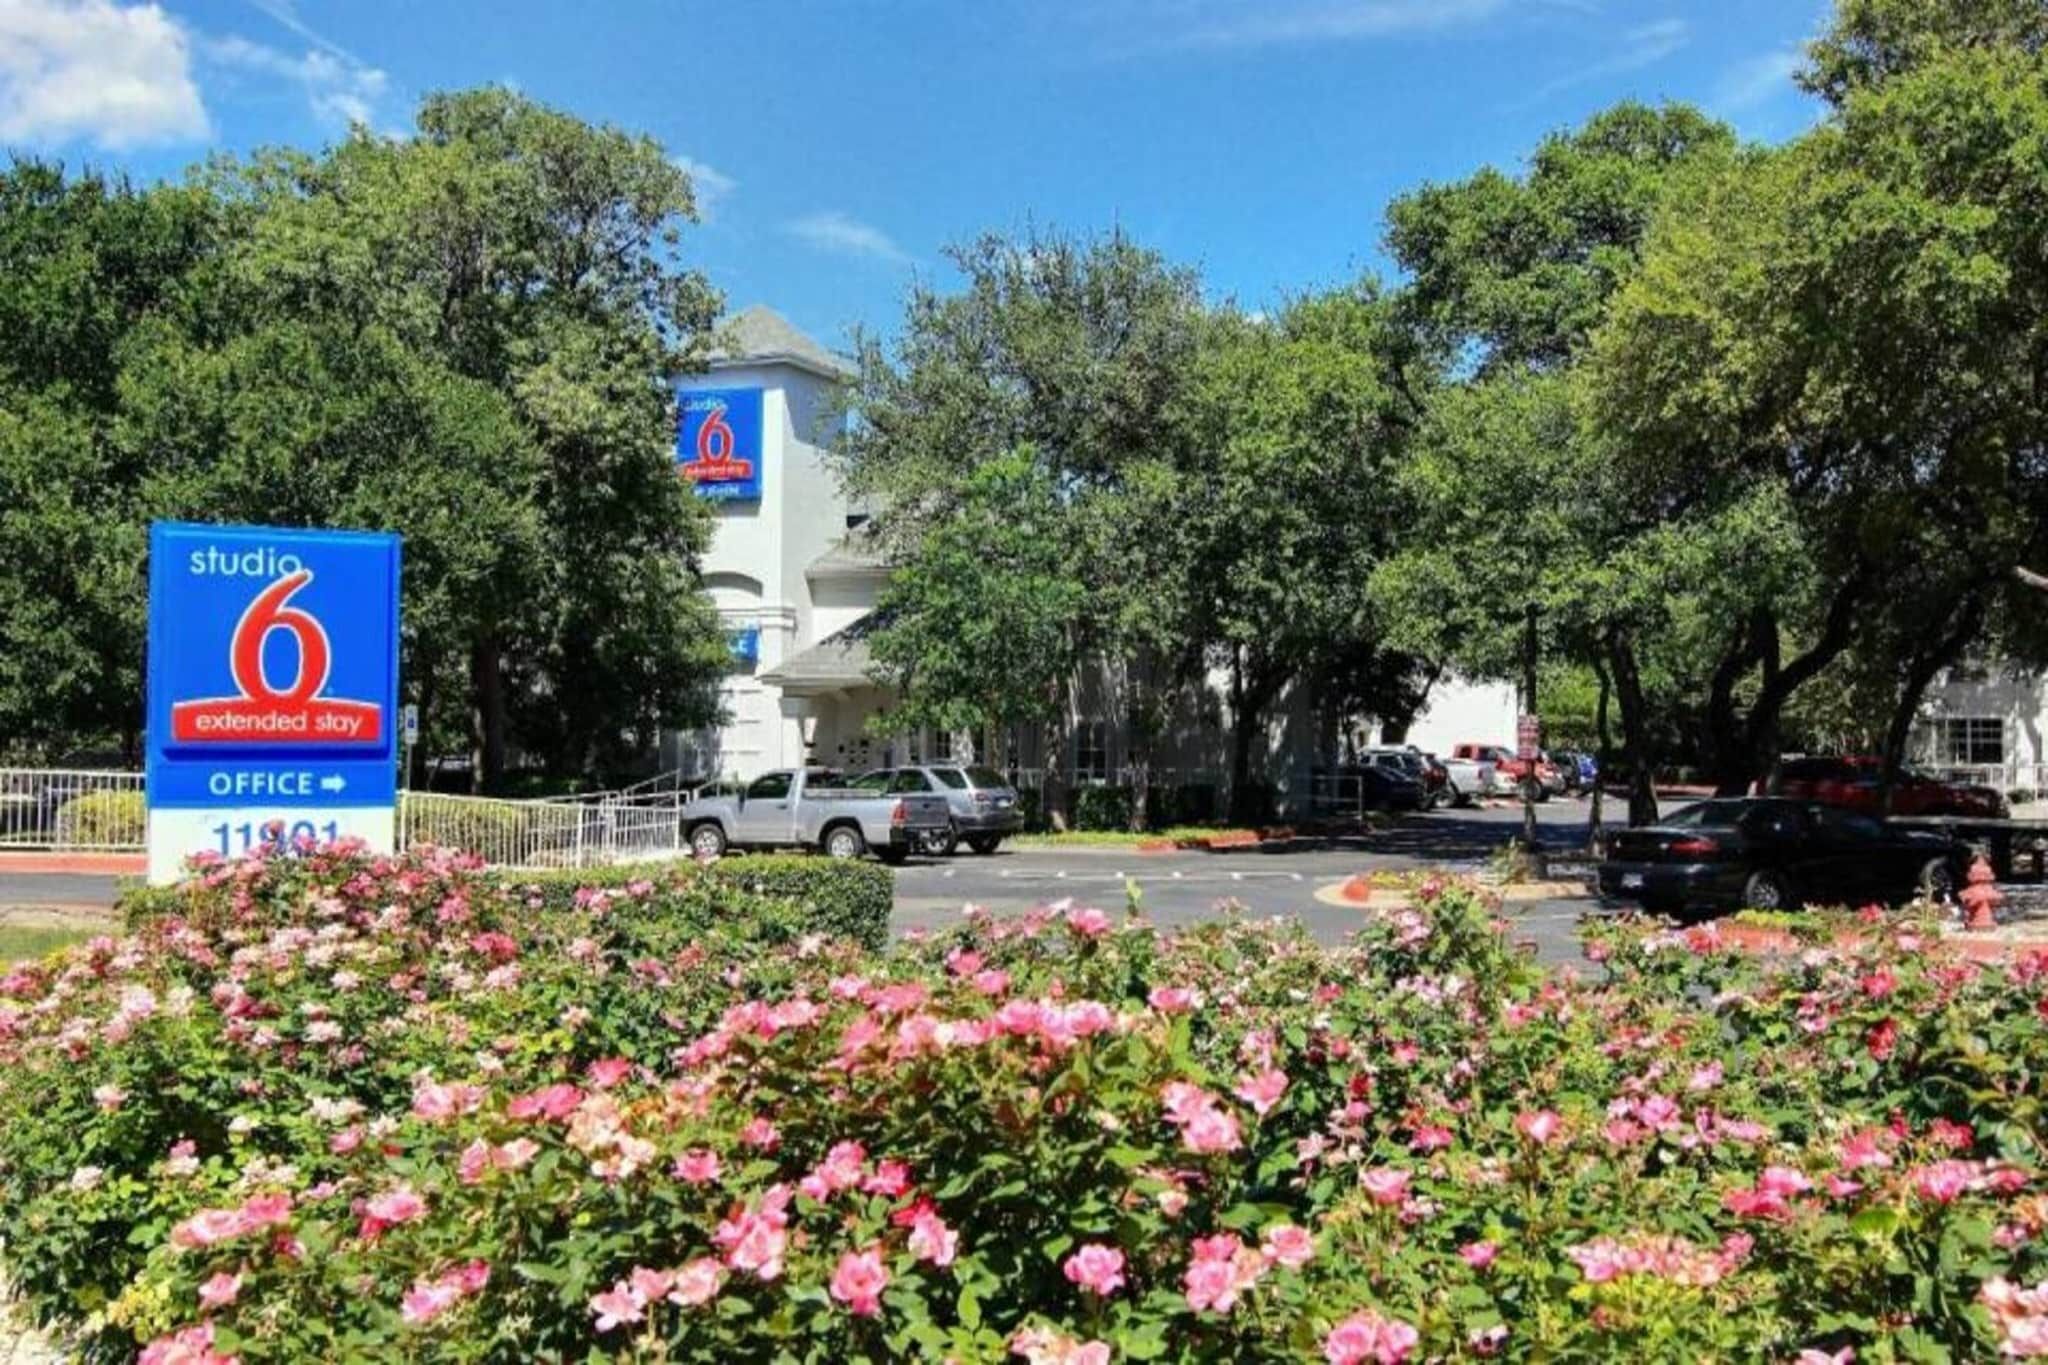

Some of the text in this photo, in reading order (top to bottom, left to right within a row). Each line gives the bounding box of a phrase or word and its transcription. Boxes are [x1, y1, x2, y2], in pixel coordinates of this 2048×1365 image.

[698, 404, 734, 461] 6
[190, 545, 302, 576] studio
[230, 568, 331, 701] 6
[195, 711, 362, 737] extended stay
[209, 772, 313, 796] OFFICE
